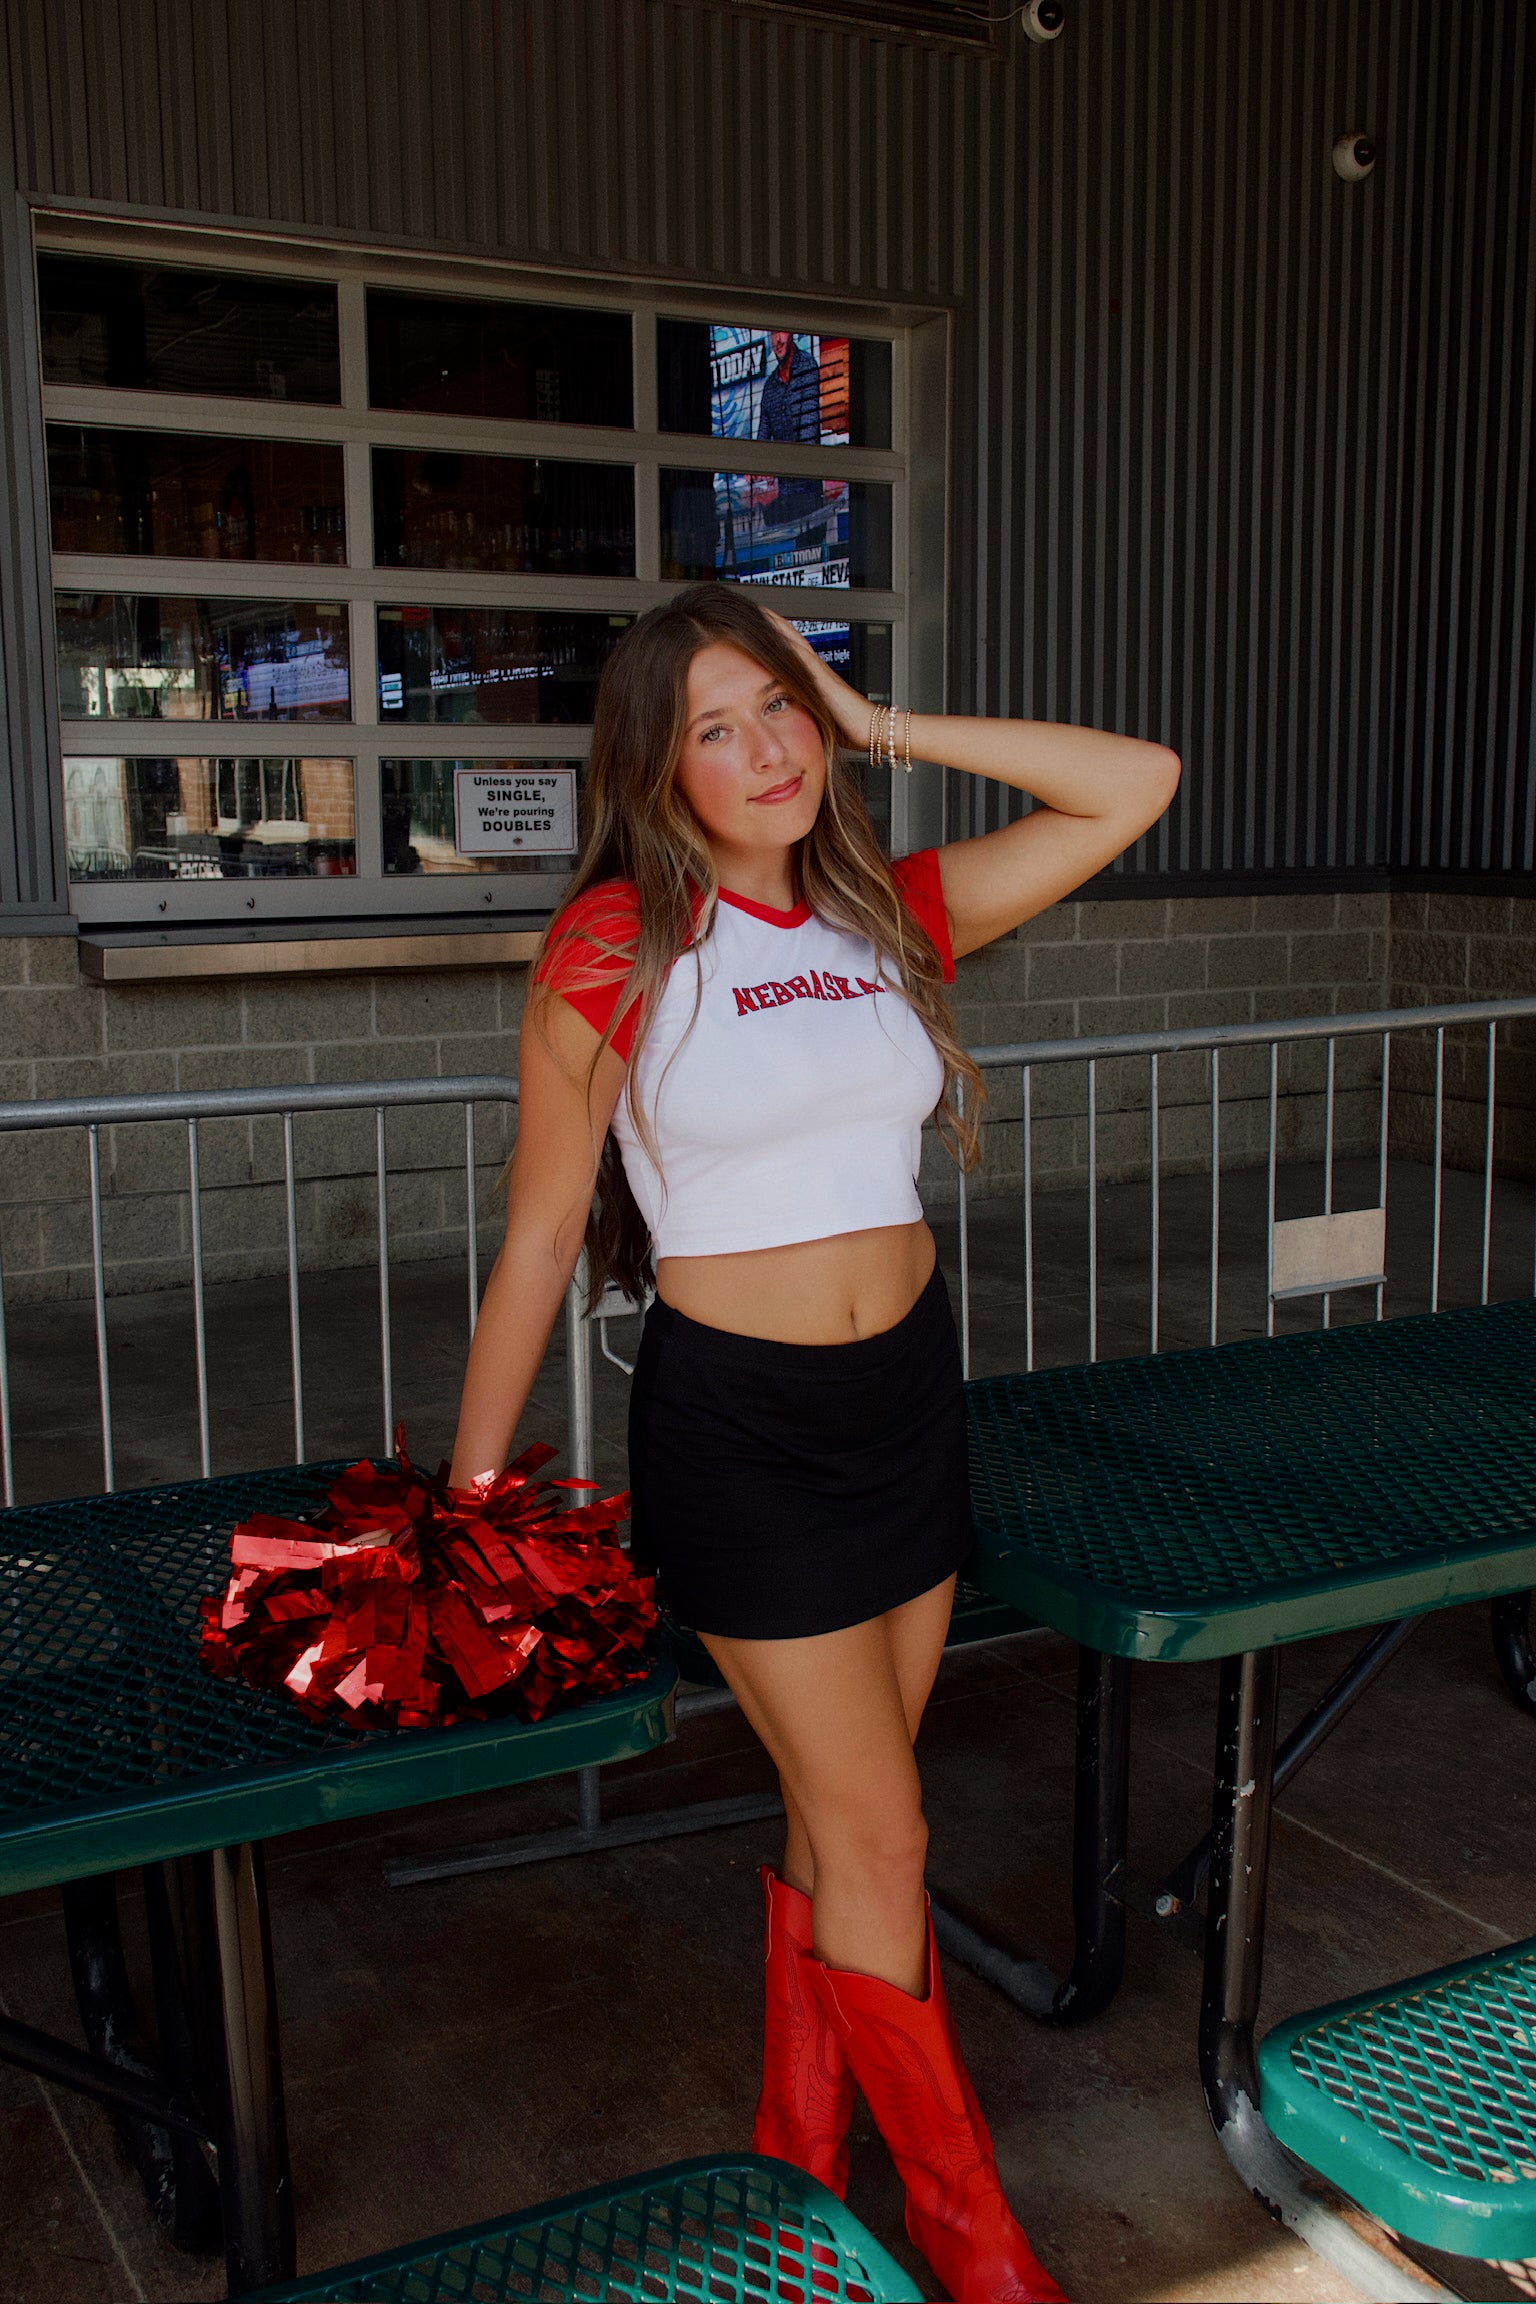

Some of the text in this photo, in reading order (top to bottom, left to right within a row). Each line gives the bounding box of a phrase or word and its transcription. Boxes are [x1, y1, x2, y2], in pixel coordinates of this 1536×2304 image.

[710, 344, 763, 388] TODAY
[793, 547, 822, 567] TODAY
[474, 777, 557, 787] Unless you say
[487, 790, 545, 802] SINGLE,
[478, 807, 554, 818] We're pouring
[483, 820, 551, 832] DOUBLES
[732, 969, 886, 1016] NEBRASKA
